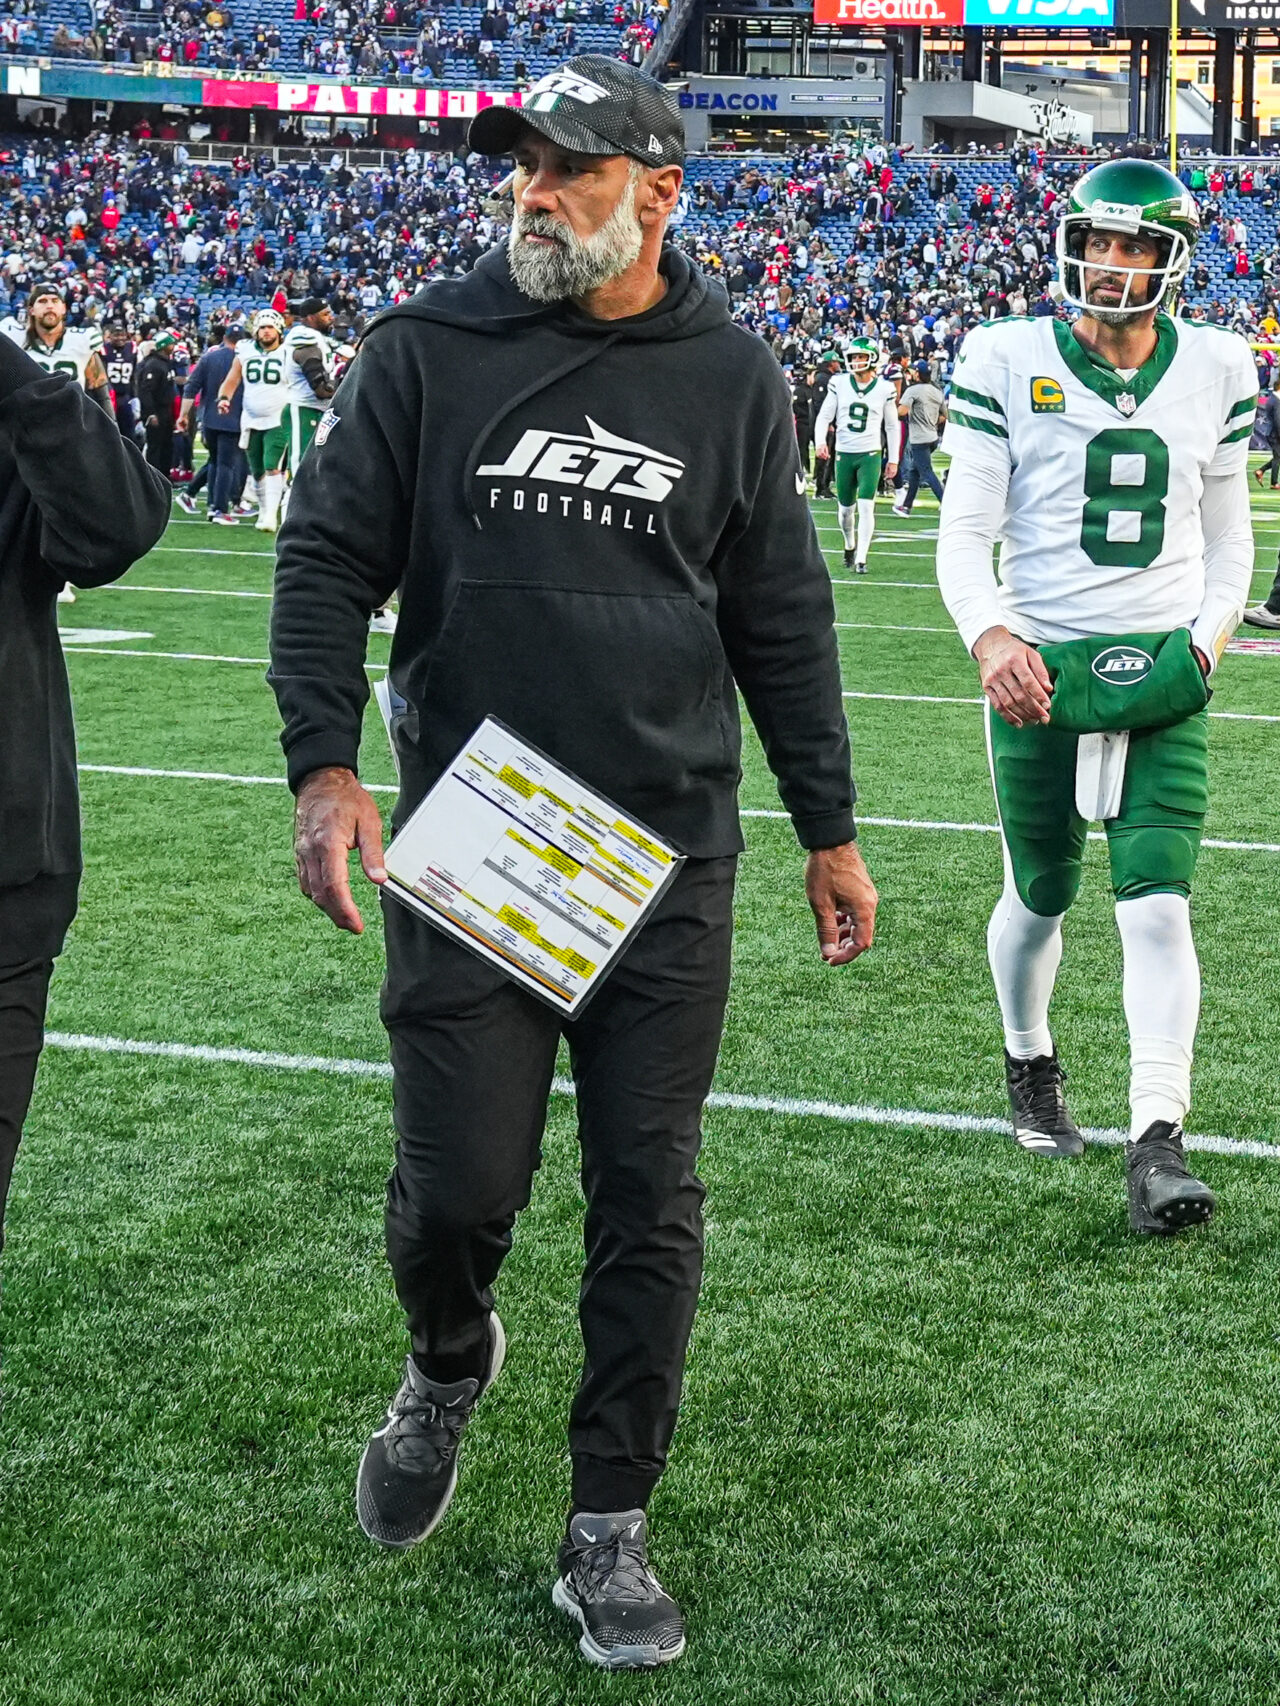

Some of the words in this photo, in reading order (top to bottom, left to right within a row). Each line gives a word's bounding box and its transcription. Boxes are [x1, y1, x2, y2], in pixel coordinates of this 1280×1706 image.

[7, 65, 41, 96] N
[277, 83, 534, 118] PATRIOT
[679, 92, 778, 111] BEACON
[106, 362, 135, 385] 59
[246, 358, 283, 385] 66
[1032, 378, 1064, 404] C
[847, 402, 870, 433] 9
[475, 415, 686, 502] JETS
[490, 487, 657, 535] FOOTBALL
[1079, 428, 1170, 569] 8
[1098, 653, 1147, 673] JETS
